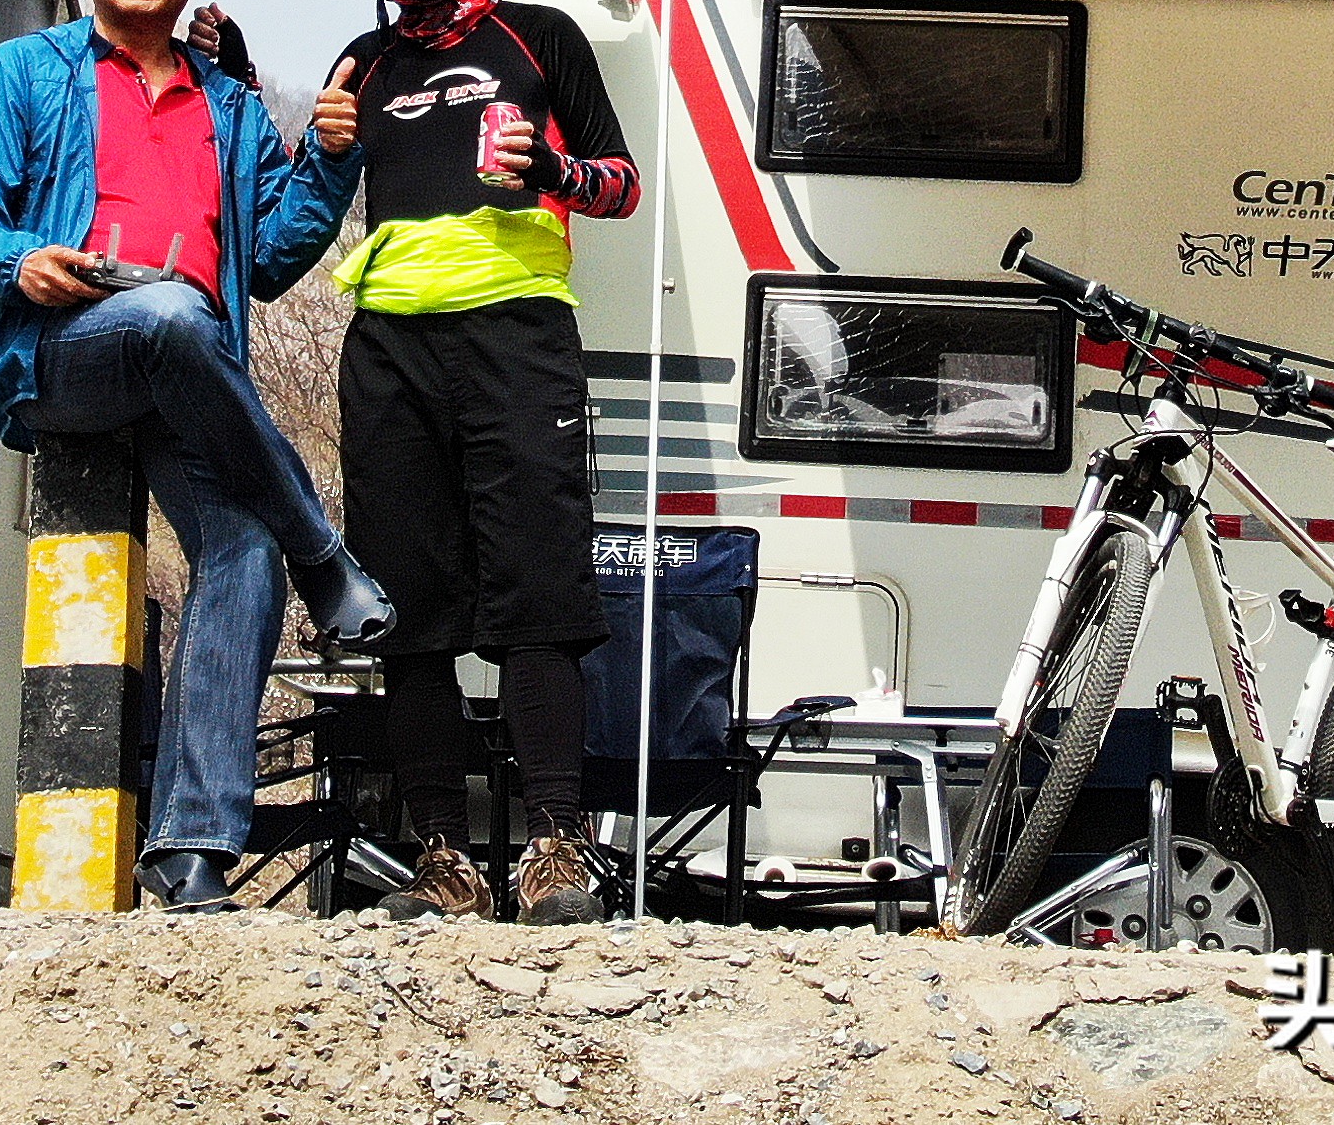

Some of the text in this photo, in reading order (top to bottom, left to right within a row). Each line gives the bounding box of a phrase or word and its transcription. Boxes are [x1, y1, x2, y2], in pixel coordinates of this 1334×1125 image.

[383, 78, 501, 112] JACK DIVE
[1227, 642, 1265, 742] MERIDA
